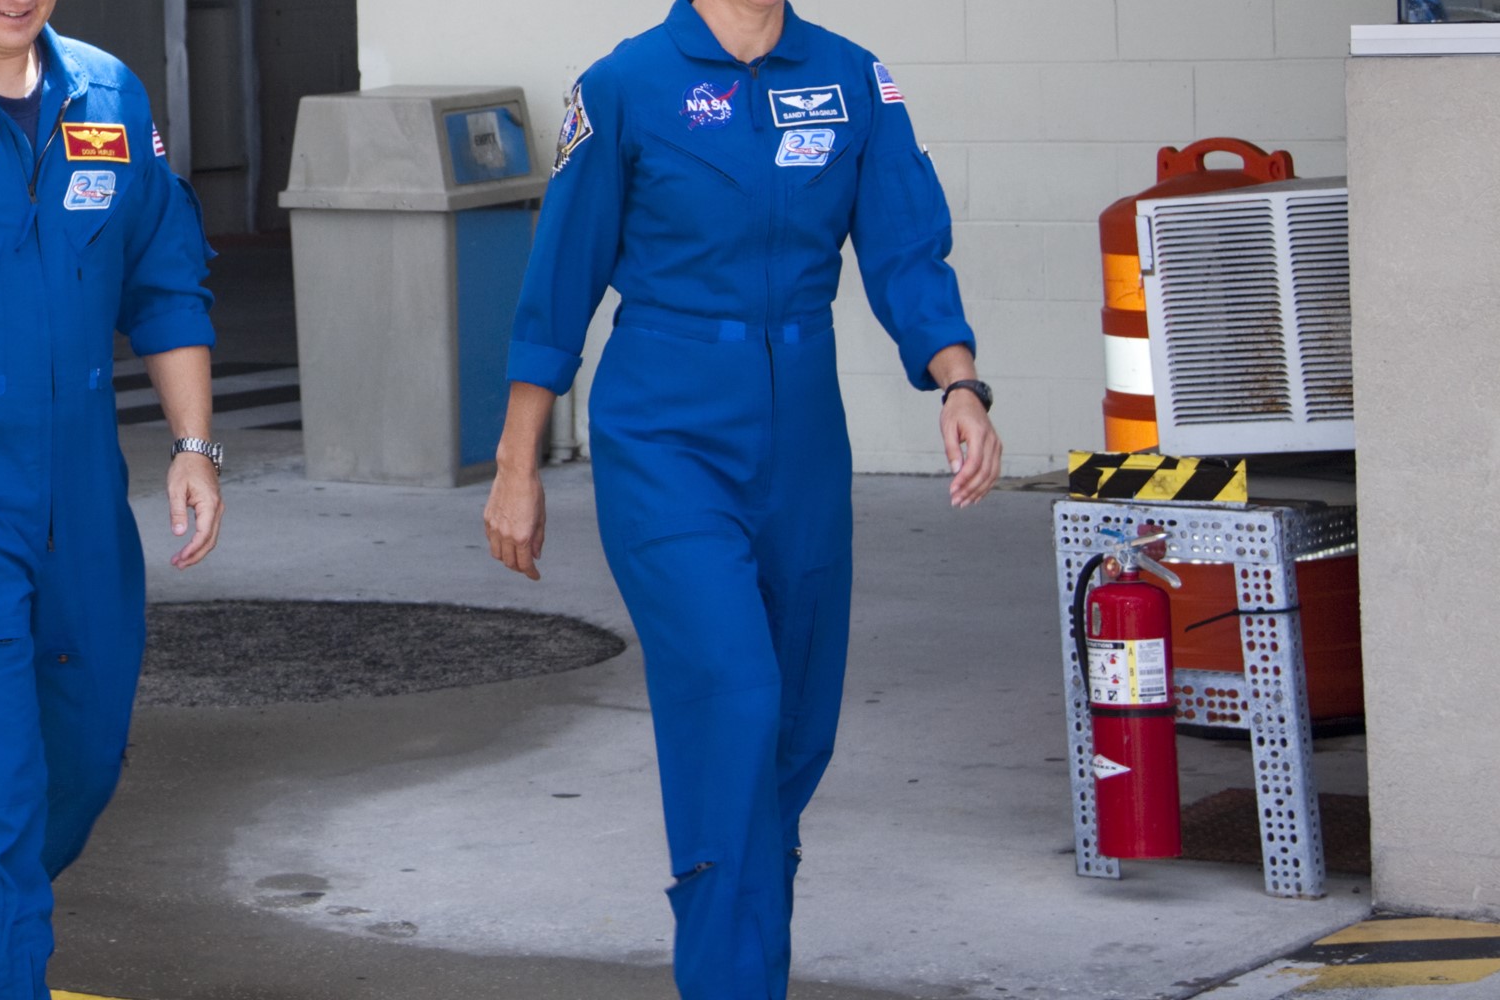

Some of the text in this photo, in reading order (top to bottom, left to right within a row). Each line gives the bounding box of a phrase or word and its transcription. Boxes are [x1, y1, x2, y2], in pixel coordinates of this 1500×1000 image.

[686, 99, 732, 112] NASA
[783, 109, 838, 119] SANDY MAGNUS
[784, 134, 826, 160] 25
[72, 176, 109, 204] 25
